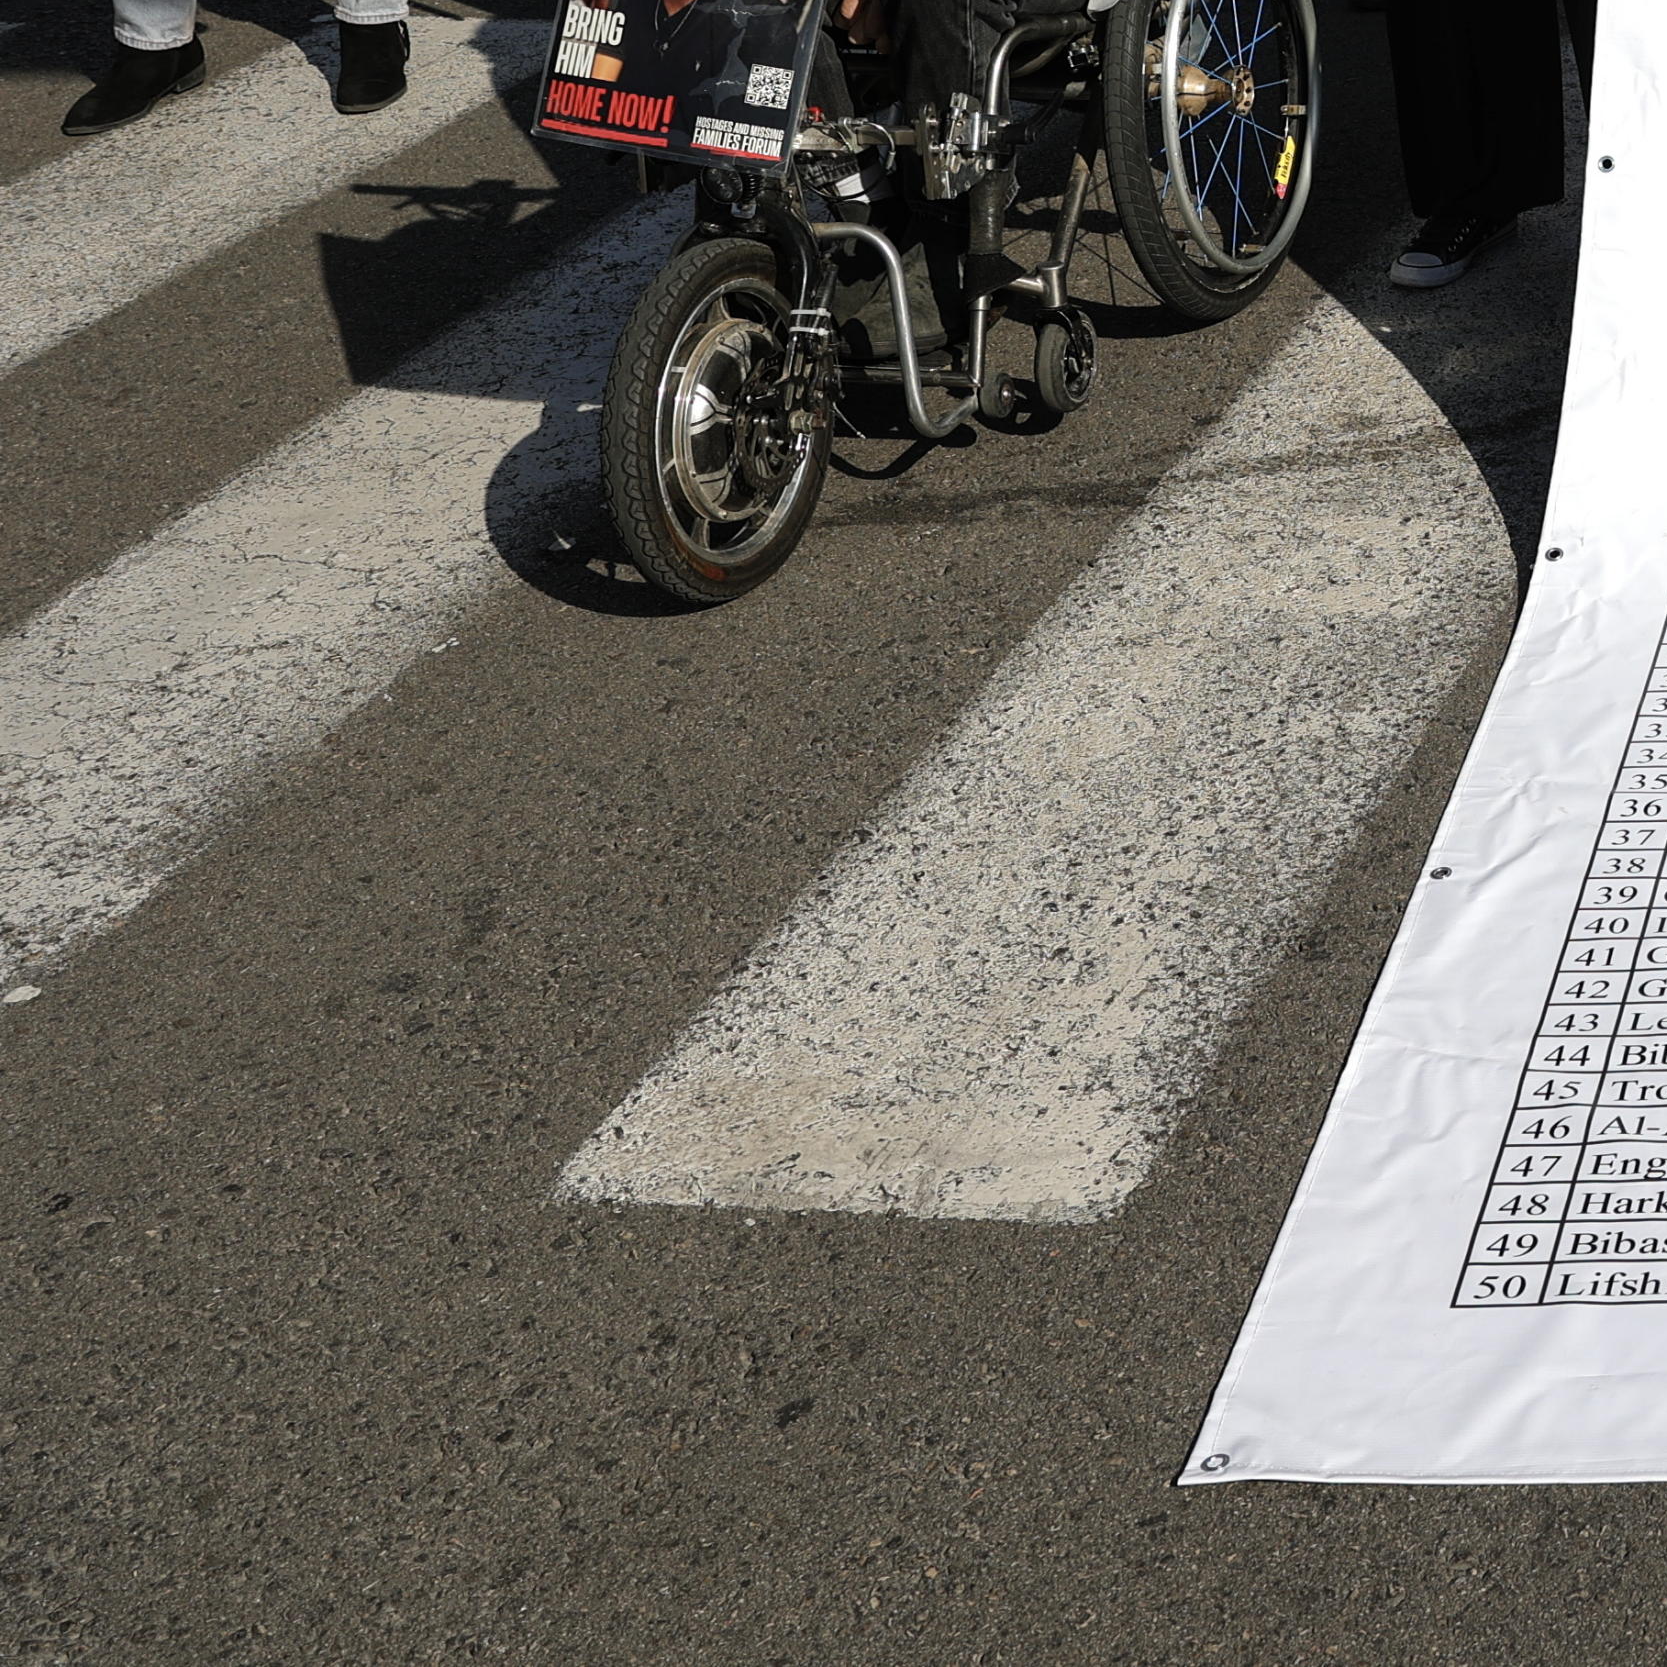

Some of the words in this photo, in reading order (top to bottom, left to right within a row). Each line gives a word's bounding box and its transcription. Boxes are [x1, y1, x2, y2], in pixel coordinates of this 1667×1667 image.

[564, 6, 625, 46] BRING
[554, 39, 596, 78] HIM
[1532, 1078, 1582, 1102] 45
[1472, 1274, 1527, 1300] 50
